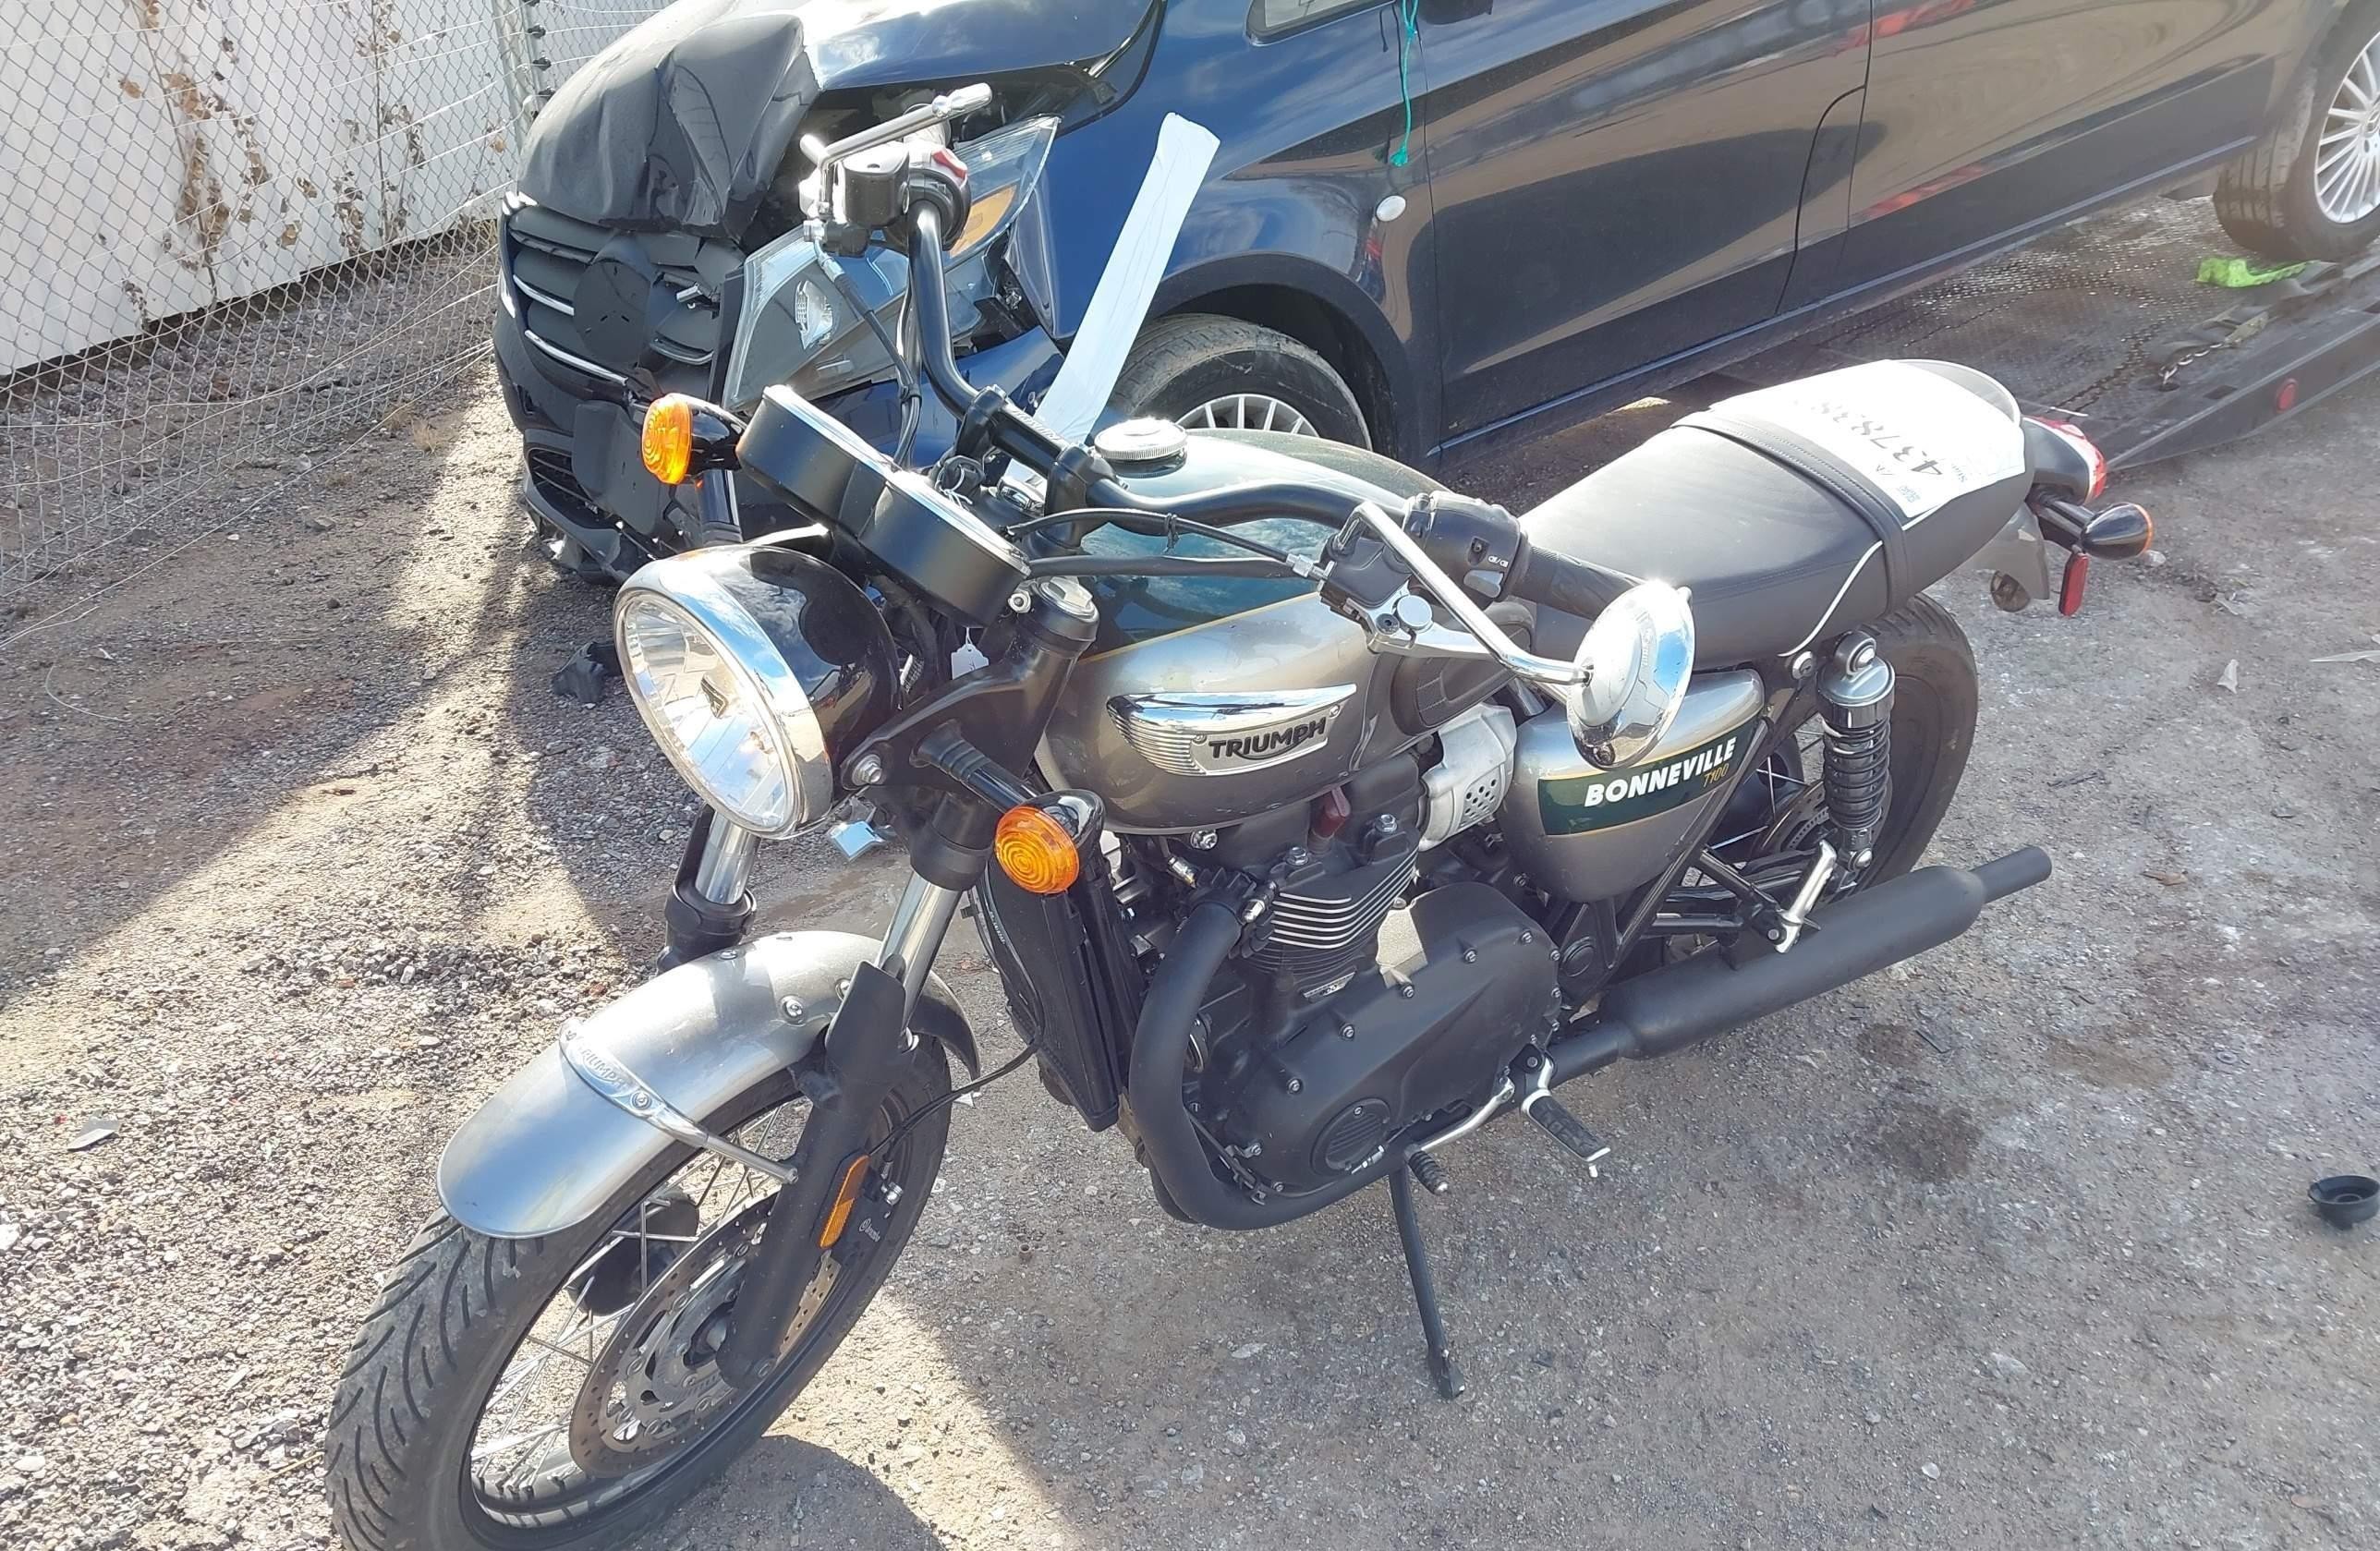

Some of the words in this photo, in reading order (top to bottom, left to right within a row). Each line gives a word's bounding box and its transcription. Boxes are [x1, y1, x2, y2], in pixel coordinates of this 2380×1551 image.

[1208, 716, 1327, 760] TRIUMPH
[1584, 736, 1737, 807] BONNEVILLE
[1703, 762, 1730, 788] T100
